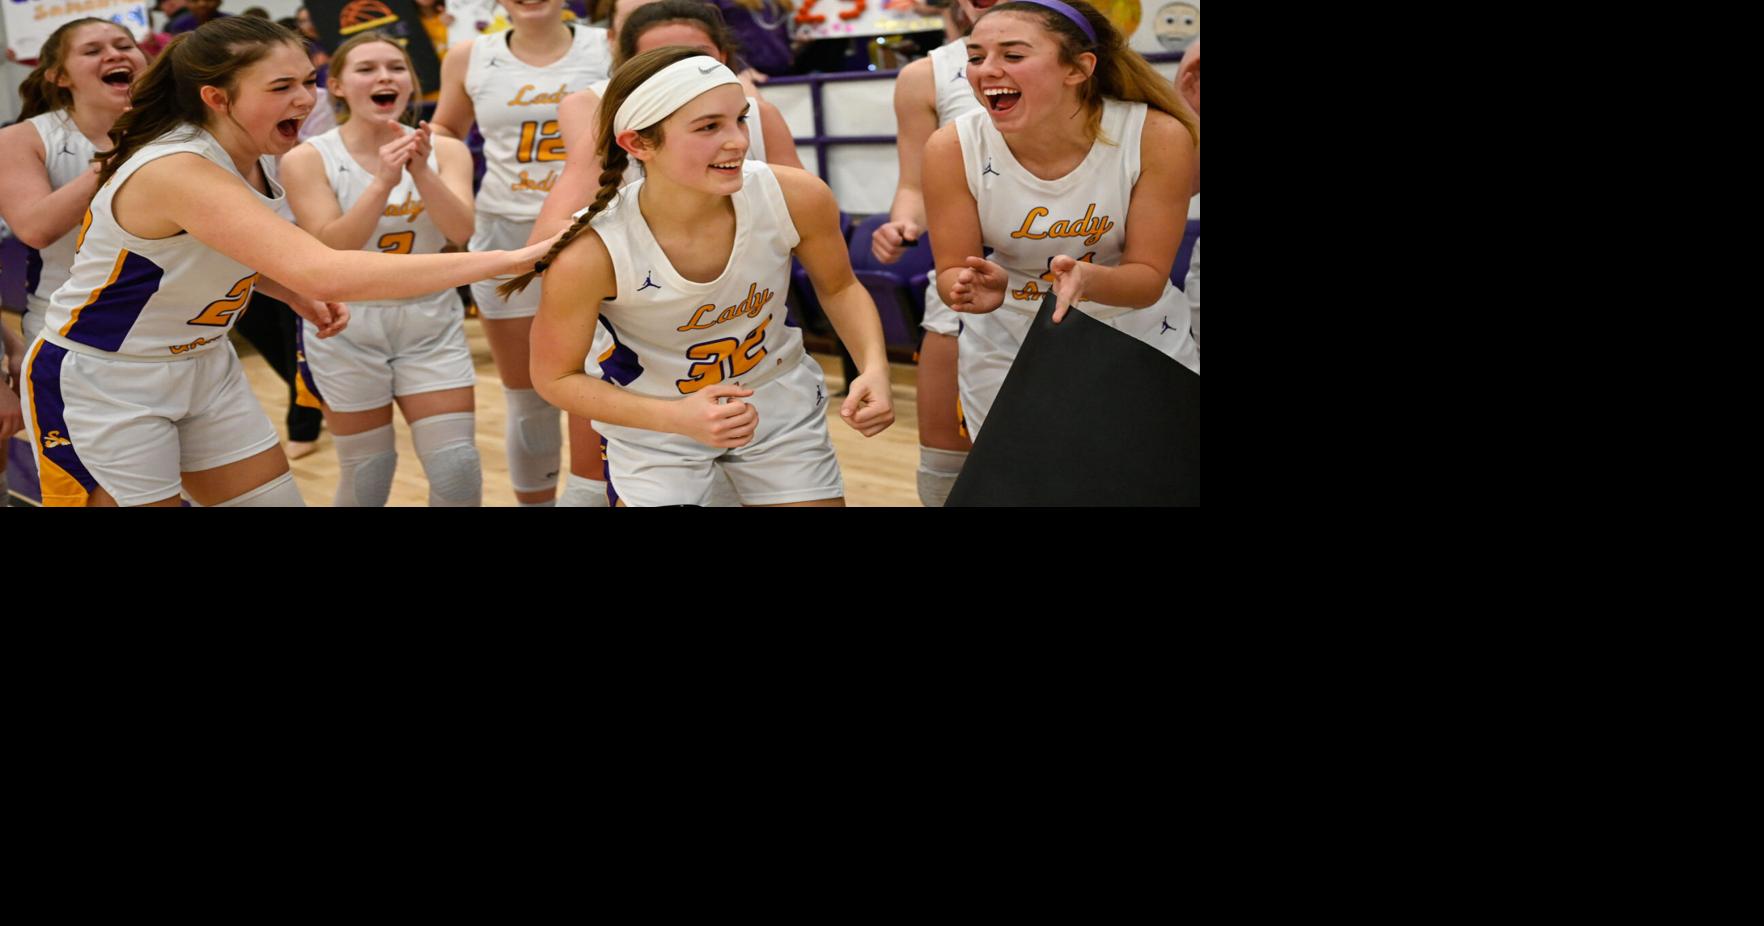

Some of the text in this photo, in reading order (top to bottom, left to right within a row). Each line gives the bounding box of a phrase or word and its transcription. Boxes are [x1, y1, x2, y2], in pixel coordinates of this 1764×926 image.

[507, 83, 575, 107] Lad
[516, 119, 569, 164] 12
[383, 191, 425, 223] ady
[1010, 203, 1114, 246] Lady
[677, 282, 774, 332] Lady
